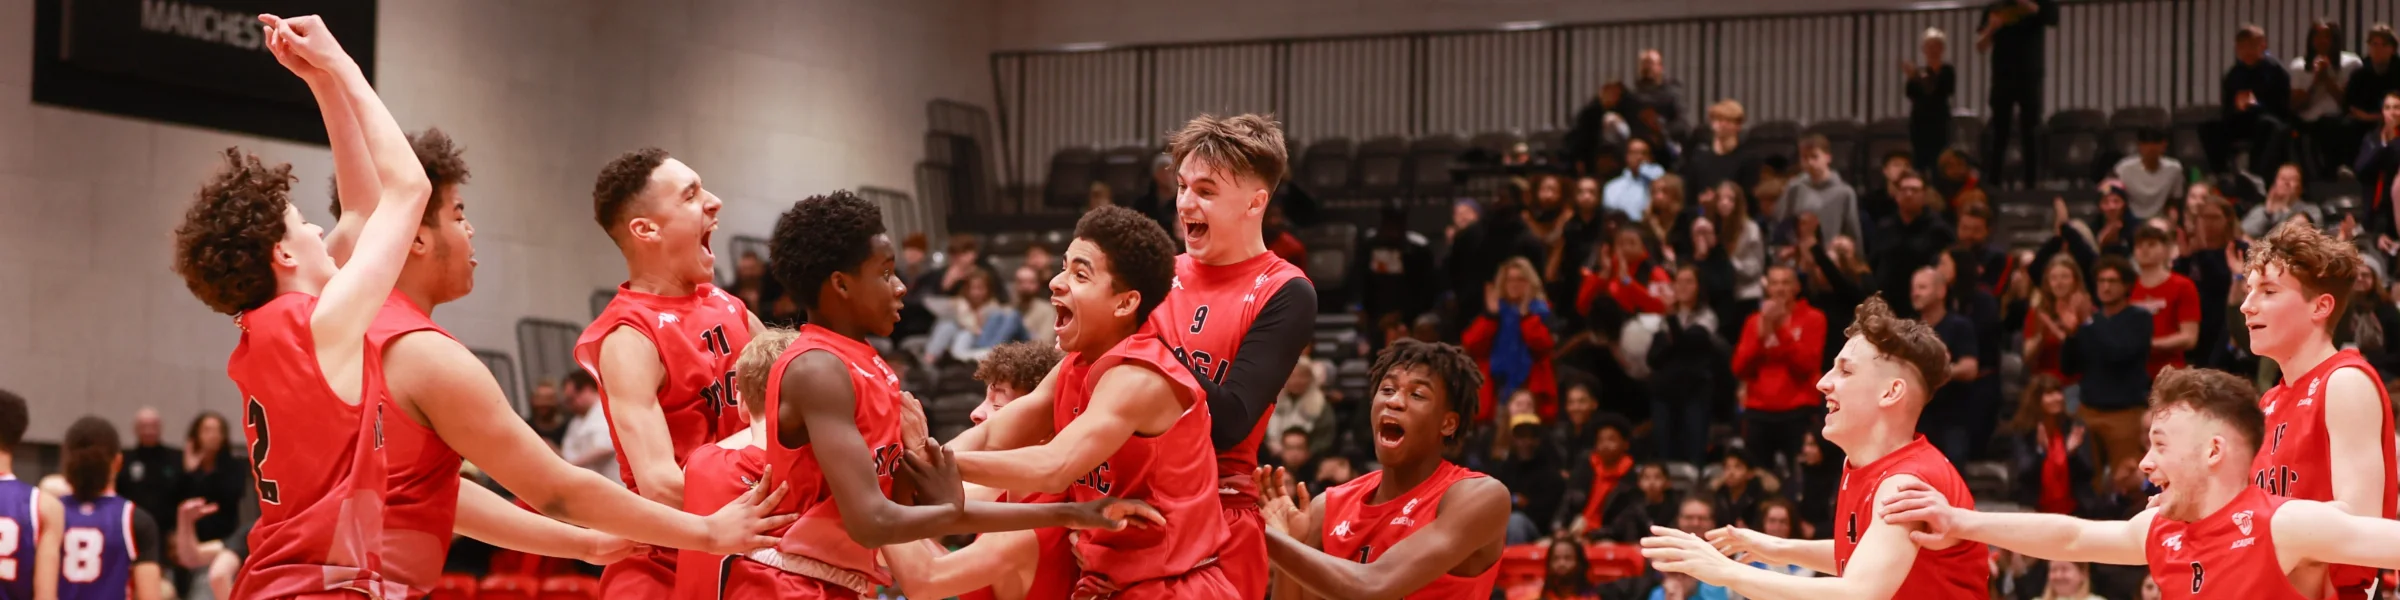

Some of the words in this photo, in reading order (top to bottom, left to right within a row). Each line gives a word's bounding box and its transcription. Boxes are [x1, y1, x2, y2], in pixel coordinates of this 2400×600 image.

[700, 324, 731, 359] 11
[1189, 304, 1209, 334] 9
[247, 395, 281, 505] 2
[62, 526, 105, 583] 8
